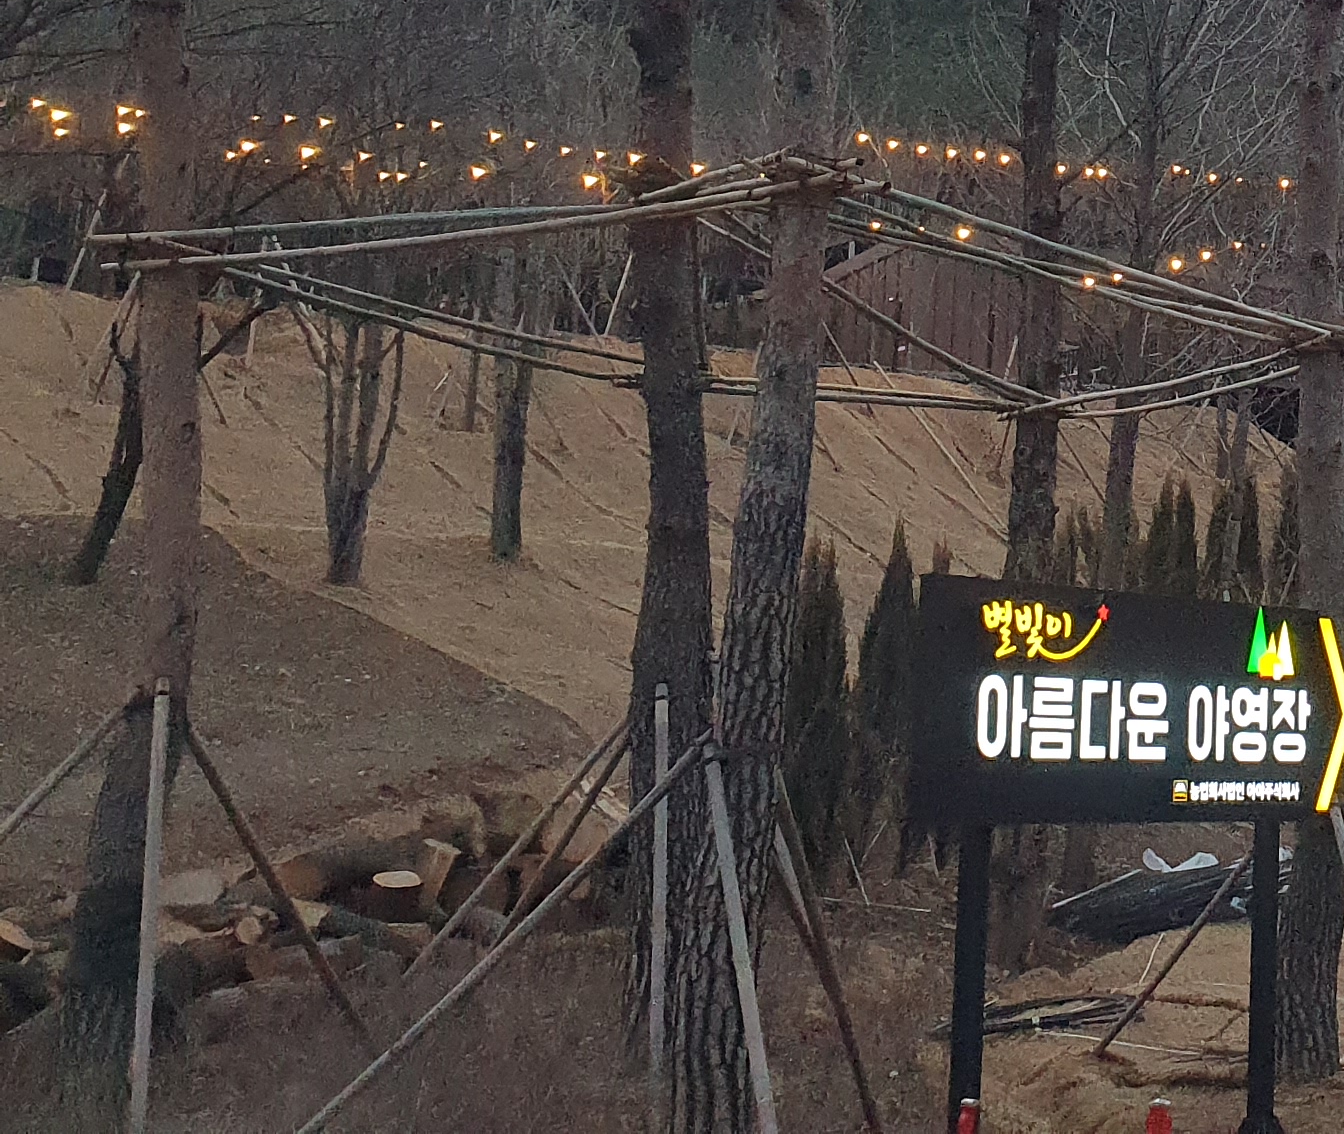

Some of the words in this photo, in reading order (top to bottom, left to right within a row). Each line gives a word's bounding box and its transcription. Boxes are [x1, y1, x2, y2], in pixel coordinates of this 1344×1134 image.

[980, 599, 1074, 660] 별빛이
[976, 674, 1170, 761] 아름다운
[1187, 683, 1312, 763] 야영장
[1189, 781, 1245, 801] 농업회사법인
